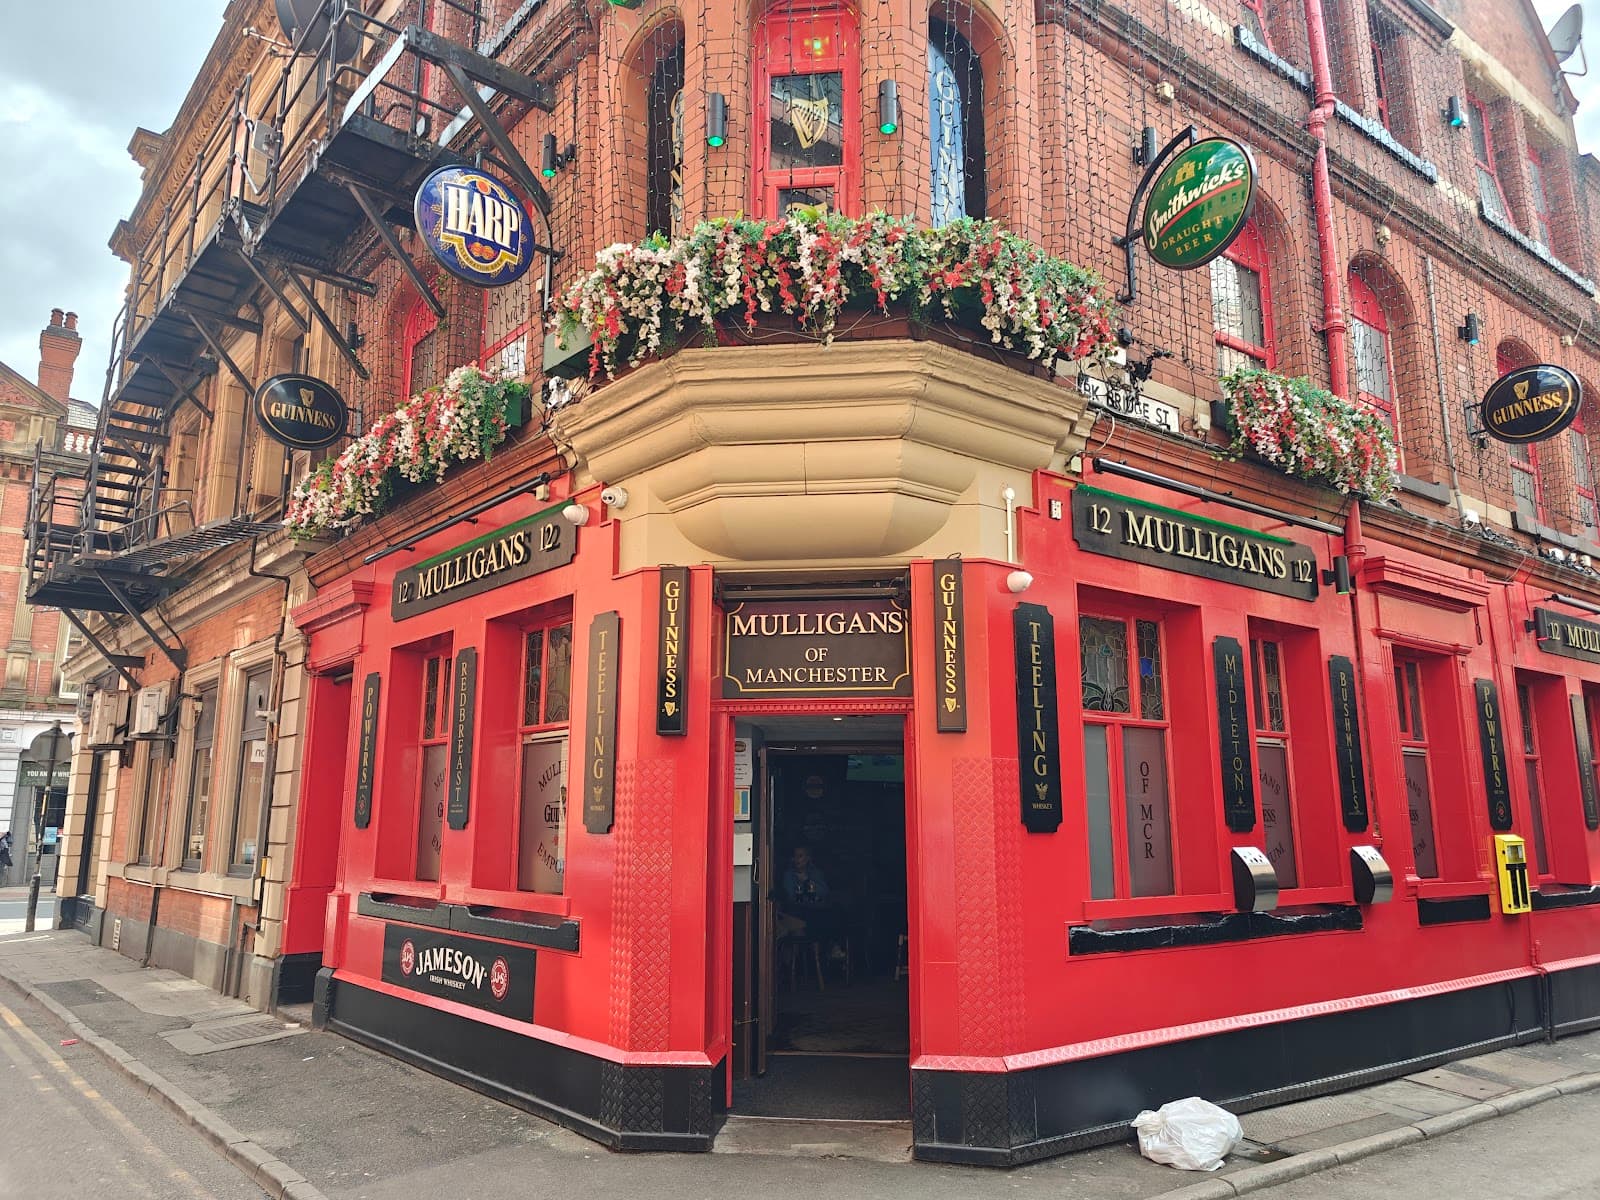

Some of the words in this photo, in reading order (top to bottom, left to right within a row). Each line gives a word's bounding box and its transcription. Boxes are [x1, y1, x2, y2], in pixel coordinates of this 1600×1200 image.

[446, 185, 519, 250] HARP
[1149, 161, 1245, 250] Smithwick's
[1161, 216, 1222, 249] DRAUGHT
[1175, 233, 1213, 256] BEER
[270, 402, 336, 430] GUINNESS
[1156, 407, 1169, 425] ST
[1493, 391, 1563, 426] GUINNESS
[398, 580, 408, 604] 12
[416, 529, 525, 600] MULLIGANS
[540, 523, 555, 552] 12
[1090, 503, 1112, 535] 12
[1125, 507, 1287, 579] MULLIGANS
[1294, 559, 1312, 583] 12
[664, 580, 680, 698] GUINNESS
[732, 611, 903, 636] MULLIGANS
[940, 573, 957, 694] GUINNESS
[1550, 622, 1560, 640] 12
[746, 667, 888, 684] MANCHESTER
[805, 647, 829, 662] OF
[592, 630, 608, 779] TEELING
[1029, 621, 1048, 777] TEELING
[1224, 653, 1245, 791] MIDLETON
[362, 687, 374, 784] POWERS
[455, 661, 468, 802] REDBREAST
[1340, 671, 1360, 810] BUSHMILLS
[1483, 685, 1501, 788] POWERS
[1140, 761, 1150, 793] OF
[1140, 803, 1155, 859] MCR
[416, 947, 485, 990] JAMESON
[429, 974, 443, 985] IRISH
[443, 977, 466, 990] WHISKEY
